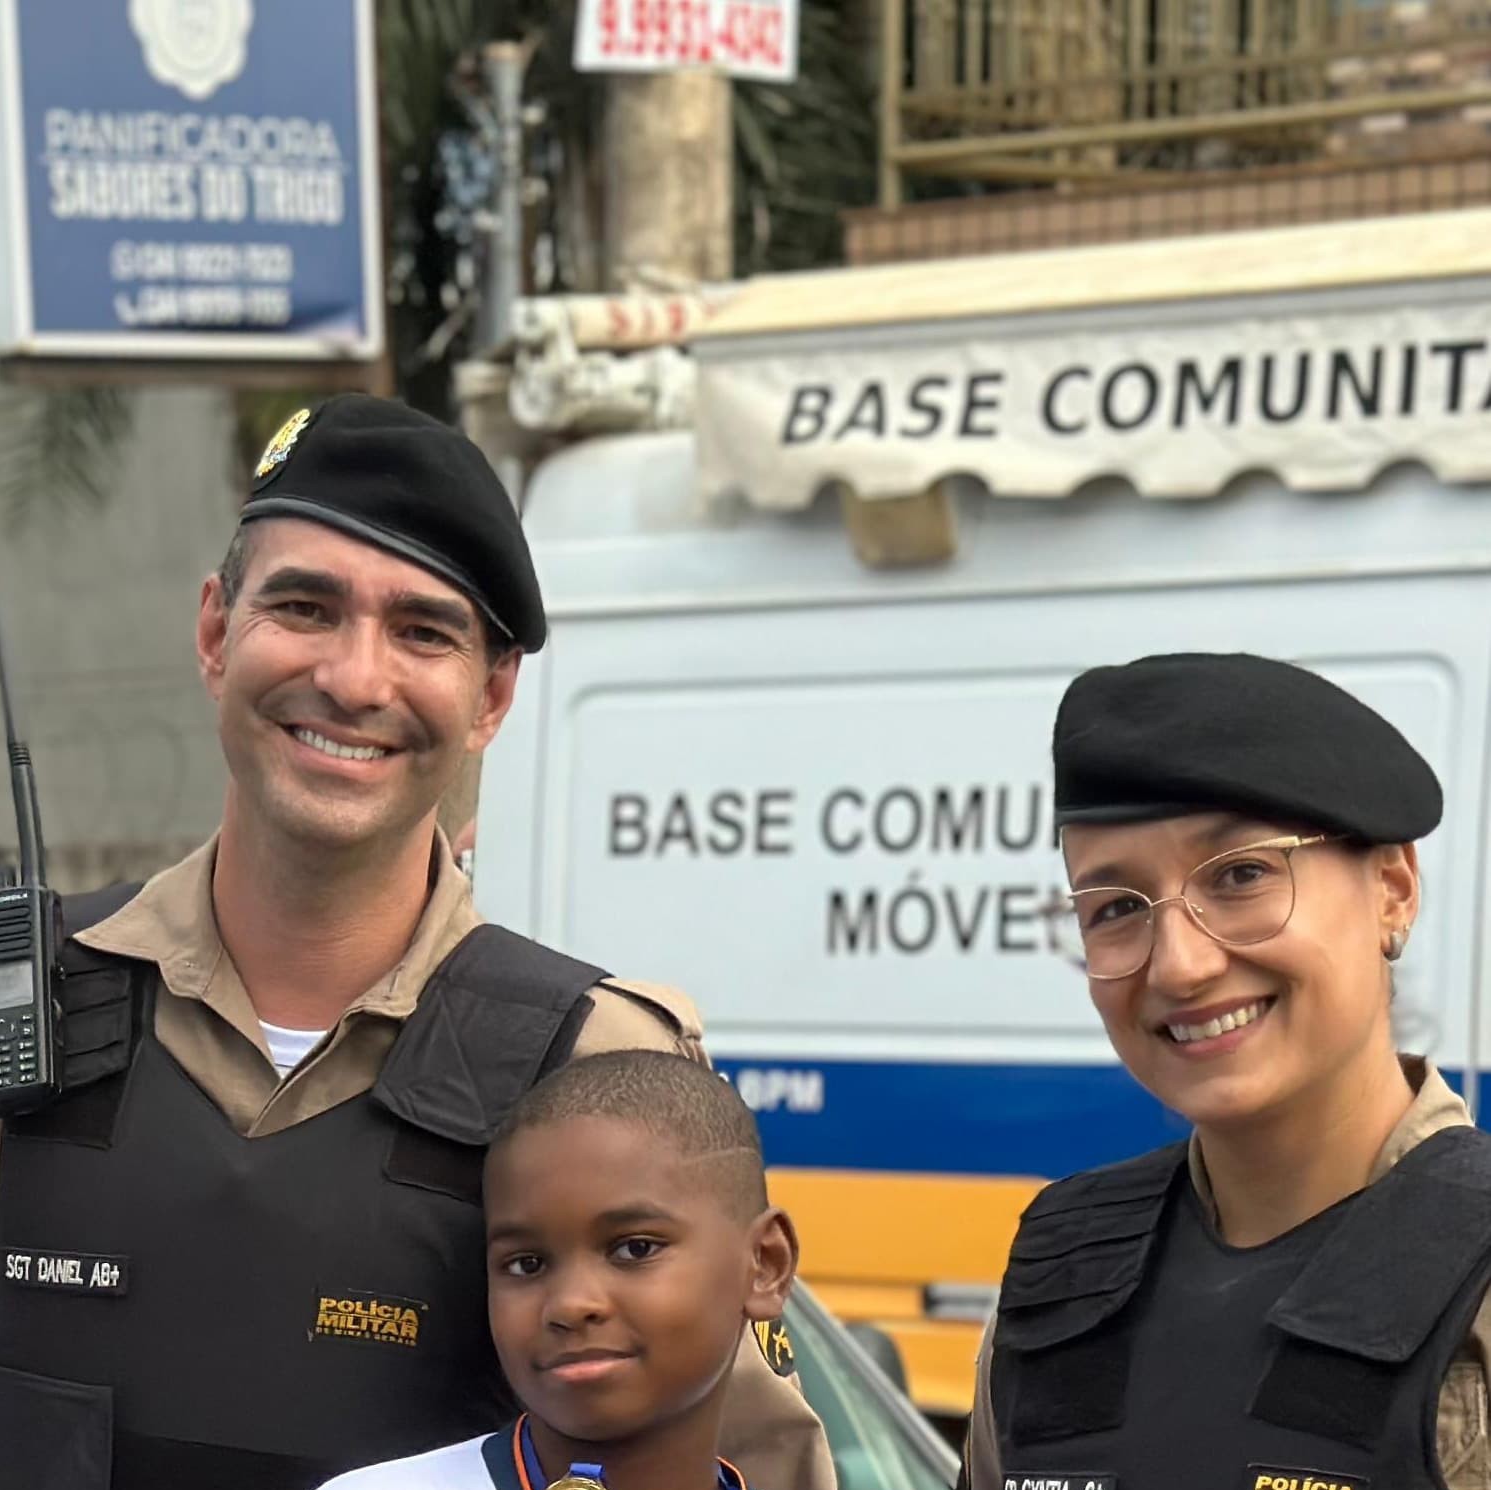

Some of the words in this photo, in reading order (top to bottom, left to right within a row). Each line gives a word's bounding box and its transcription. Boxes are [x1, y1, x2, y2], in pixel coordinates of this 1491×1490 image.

[44, 109, 341, 161] PANIFICADORA
[200, 163, 247, 222] DO
[780, 372, 1005, 446] BASE
[1041, 340, 1491, 436] COMUNIT
[608, 791, 796, 857] BASE
[820, 785, 1062, 854] COMU
[5, 1254, 32, 1281] SGT
[37, 1256, 84, 1285] DANIEL
[316, 1314, 418, 1340] MILITAR
